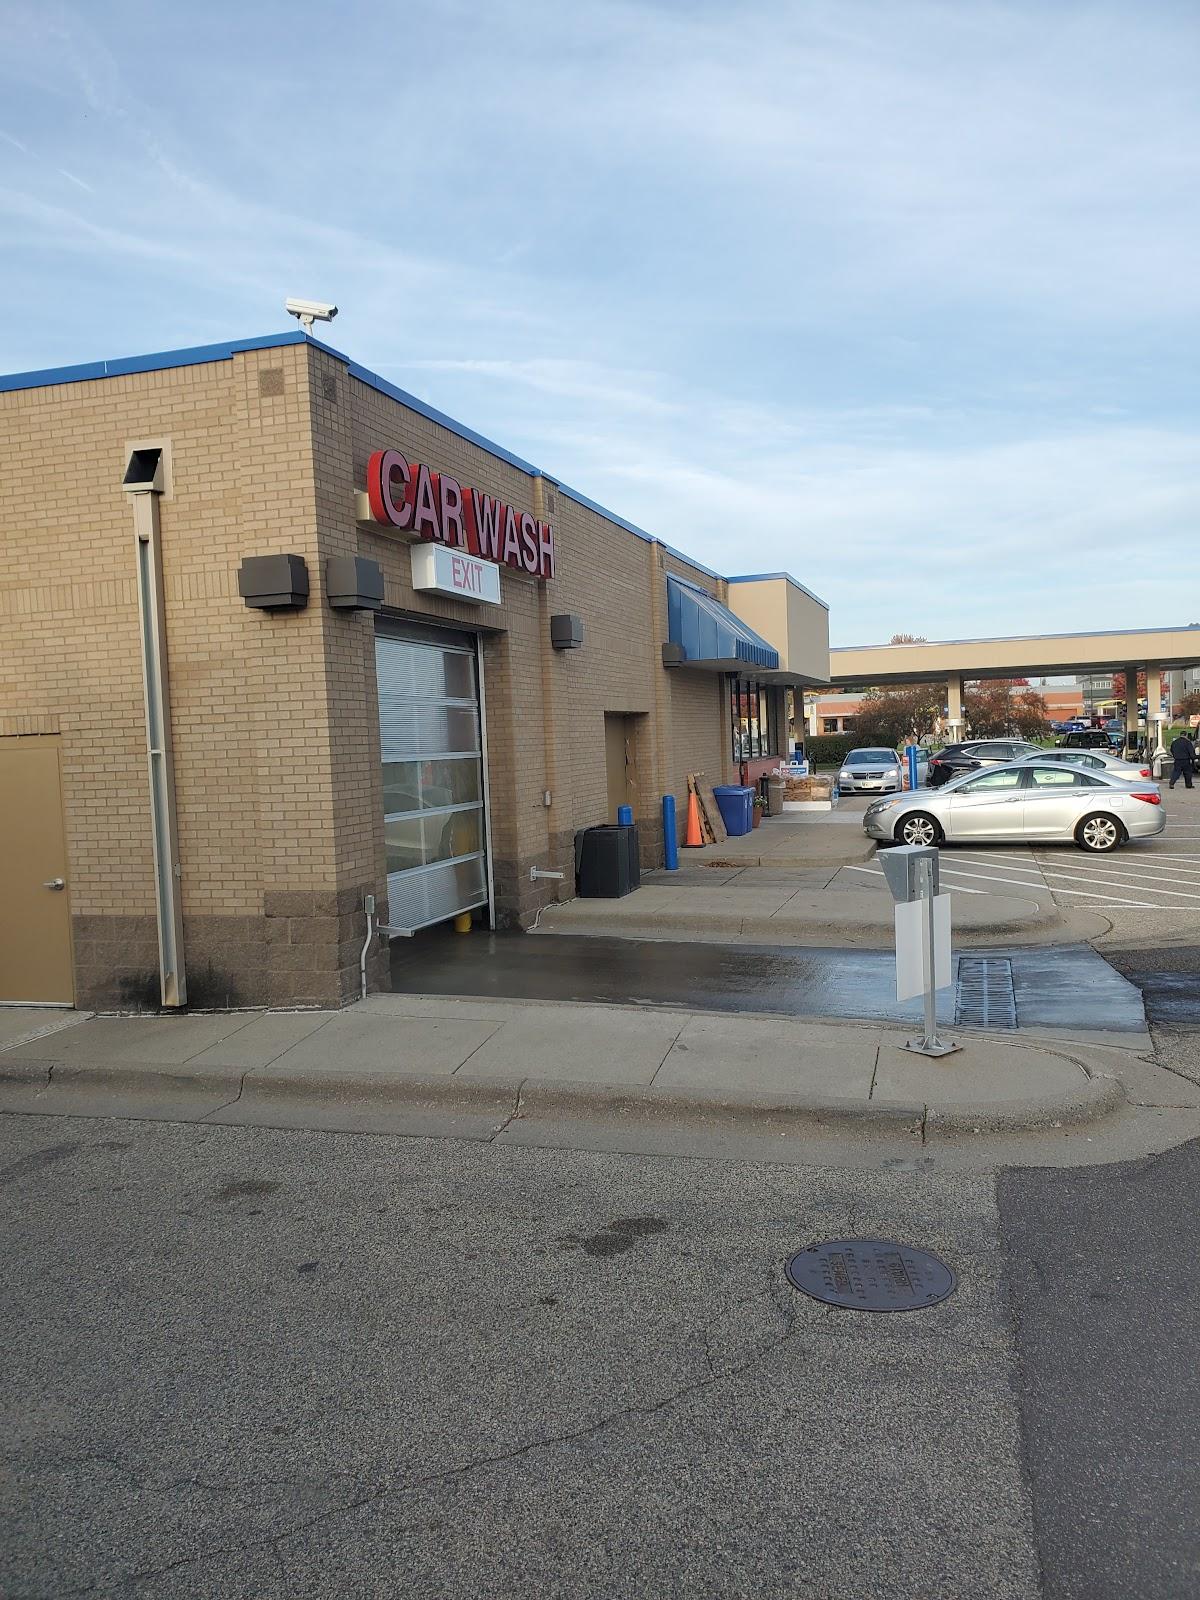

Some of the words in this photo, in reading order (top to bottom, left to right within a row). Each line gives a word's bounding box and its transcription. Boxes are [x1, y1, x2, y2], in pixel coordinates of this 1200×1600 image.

[379, 450, 464, 546] CAR
[471, 488, 555, 579] WASH
[451, 557, 482, 593] EXIT
